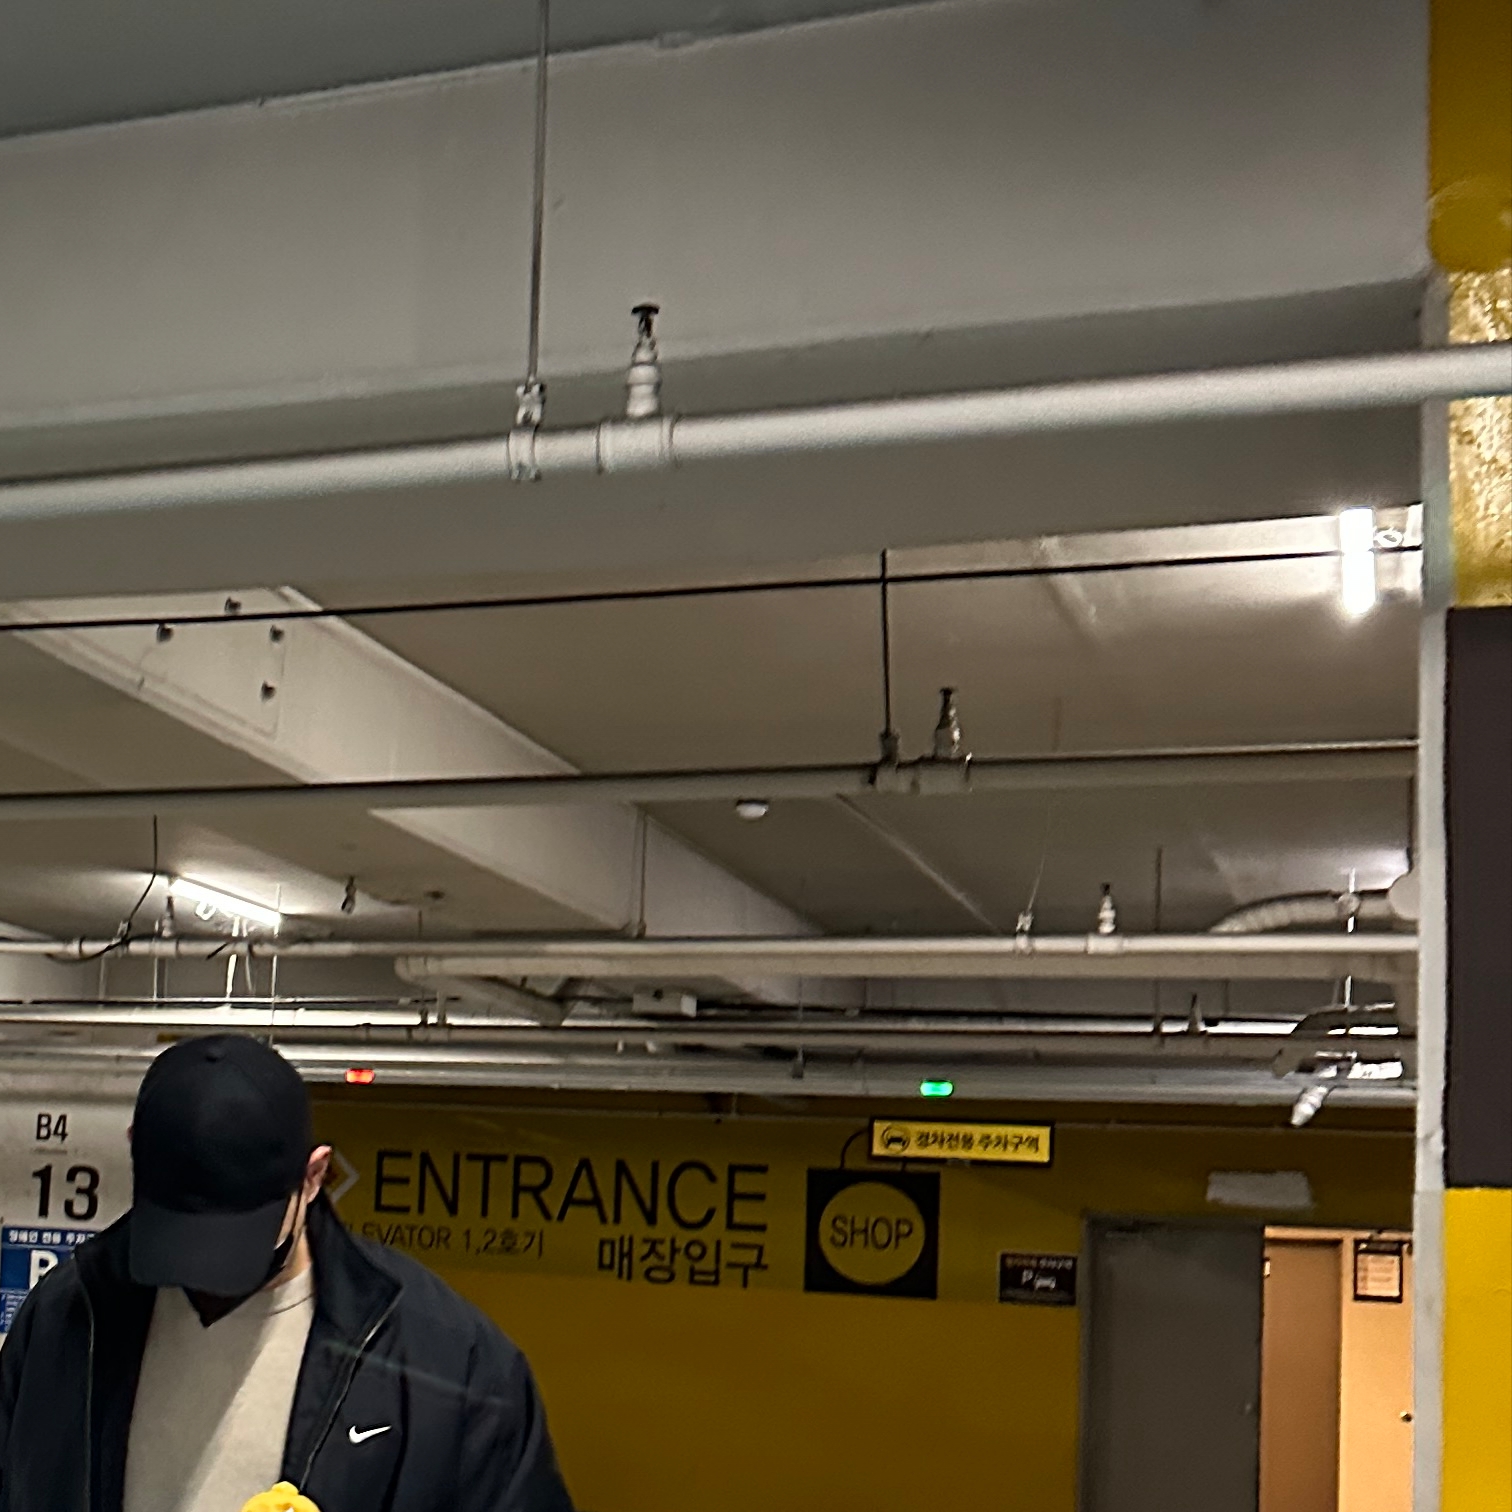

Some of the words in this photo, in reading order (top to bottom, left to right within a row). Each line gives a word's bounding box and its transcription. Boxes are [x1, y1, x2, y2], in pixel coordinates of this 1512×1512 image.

[35, 1112, 69, 1143] B4
[31, 1162, 101, 1221] 13
[372, 1148, 770, 1233] ENTRANCE
[345, 1220, 453, 1251] EVATOR
[829, 1213, 914, 1251] SHOP
[29, 1249, 59, 1290] P
[597, 1234, 769, 1289] 매장입구
